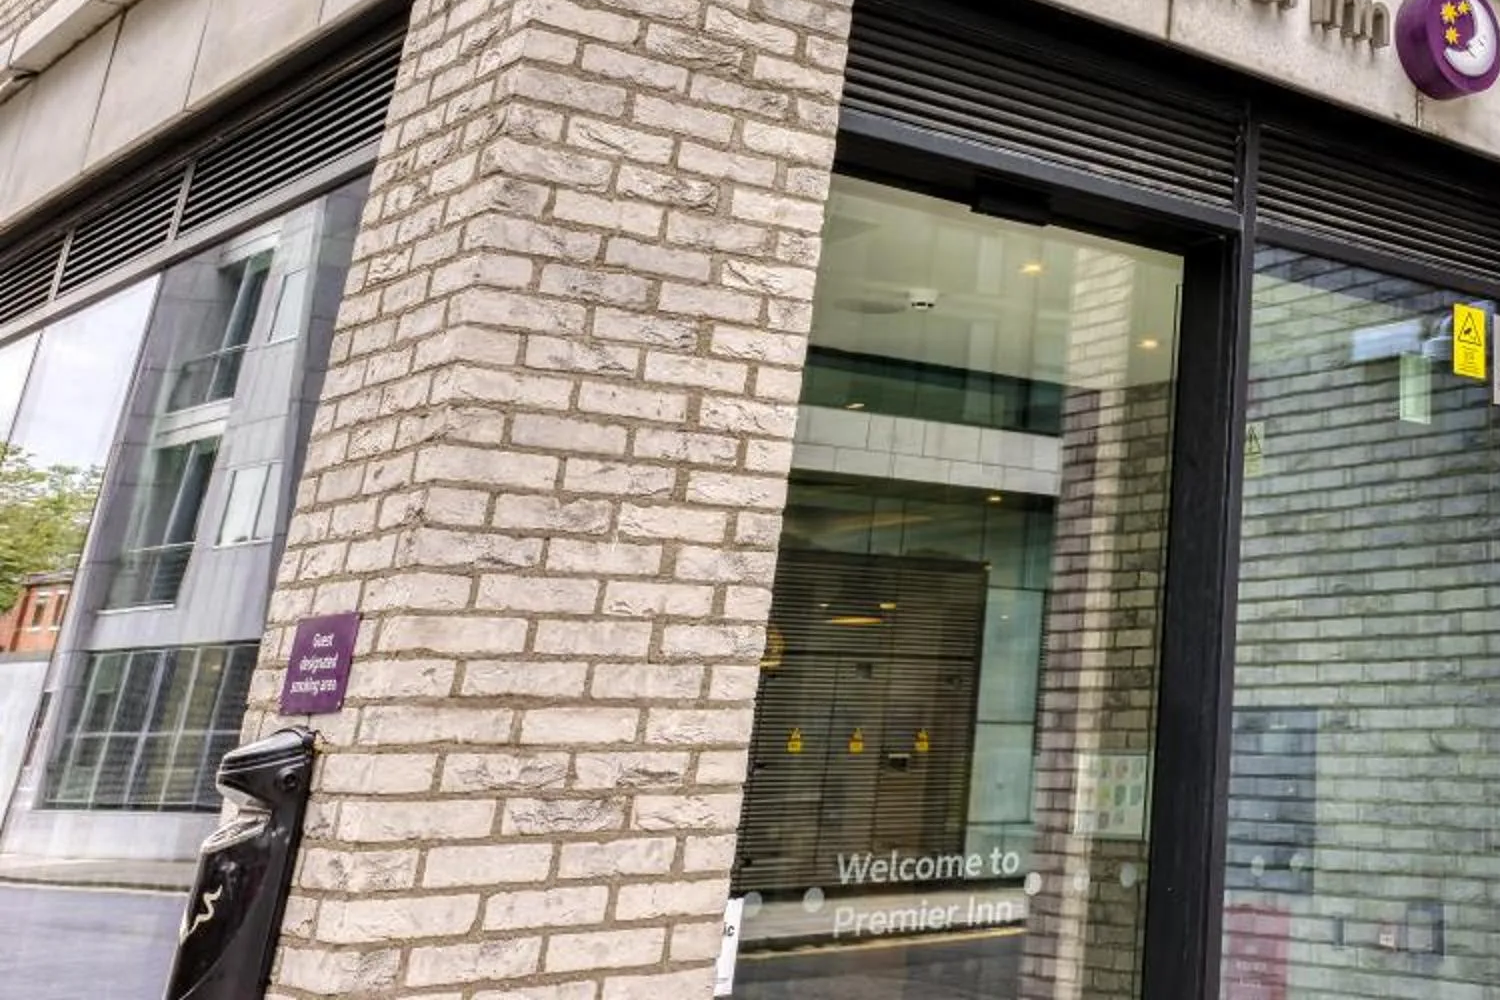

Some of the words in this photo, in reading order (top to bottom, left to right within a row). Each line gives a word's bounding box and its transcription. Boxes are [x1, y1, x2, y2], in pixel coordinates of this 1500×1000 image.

[313, 632, 335, 648] Guest
[290, 676, 320, 696] smoking
[836, 849, 983, 885] Welcome
[989, 847, 1021, 876] to
[833, 898, 960, 939] Premier
[967, 895, 1013, 927] Inn
